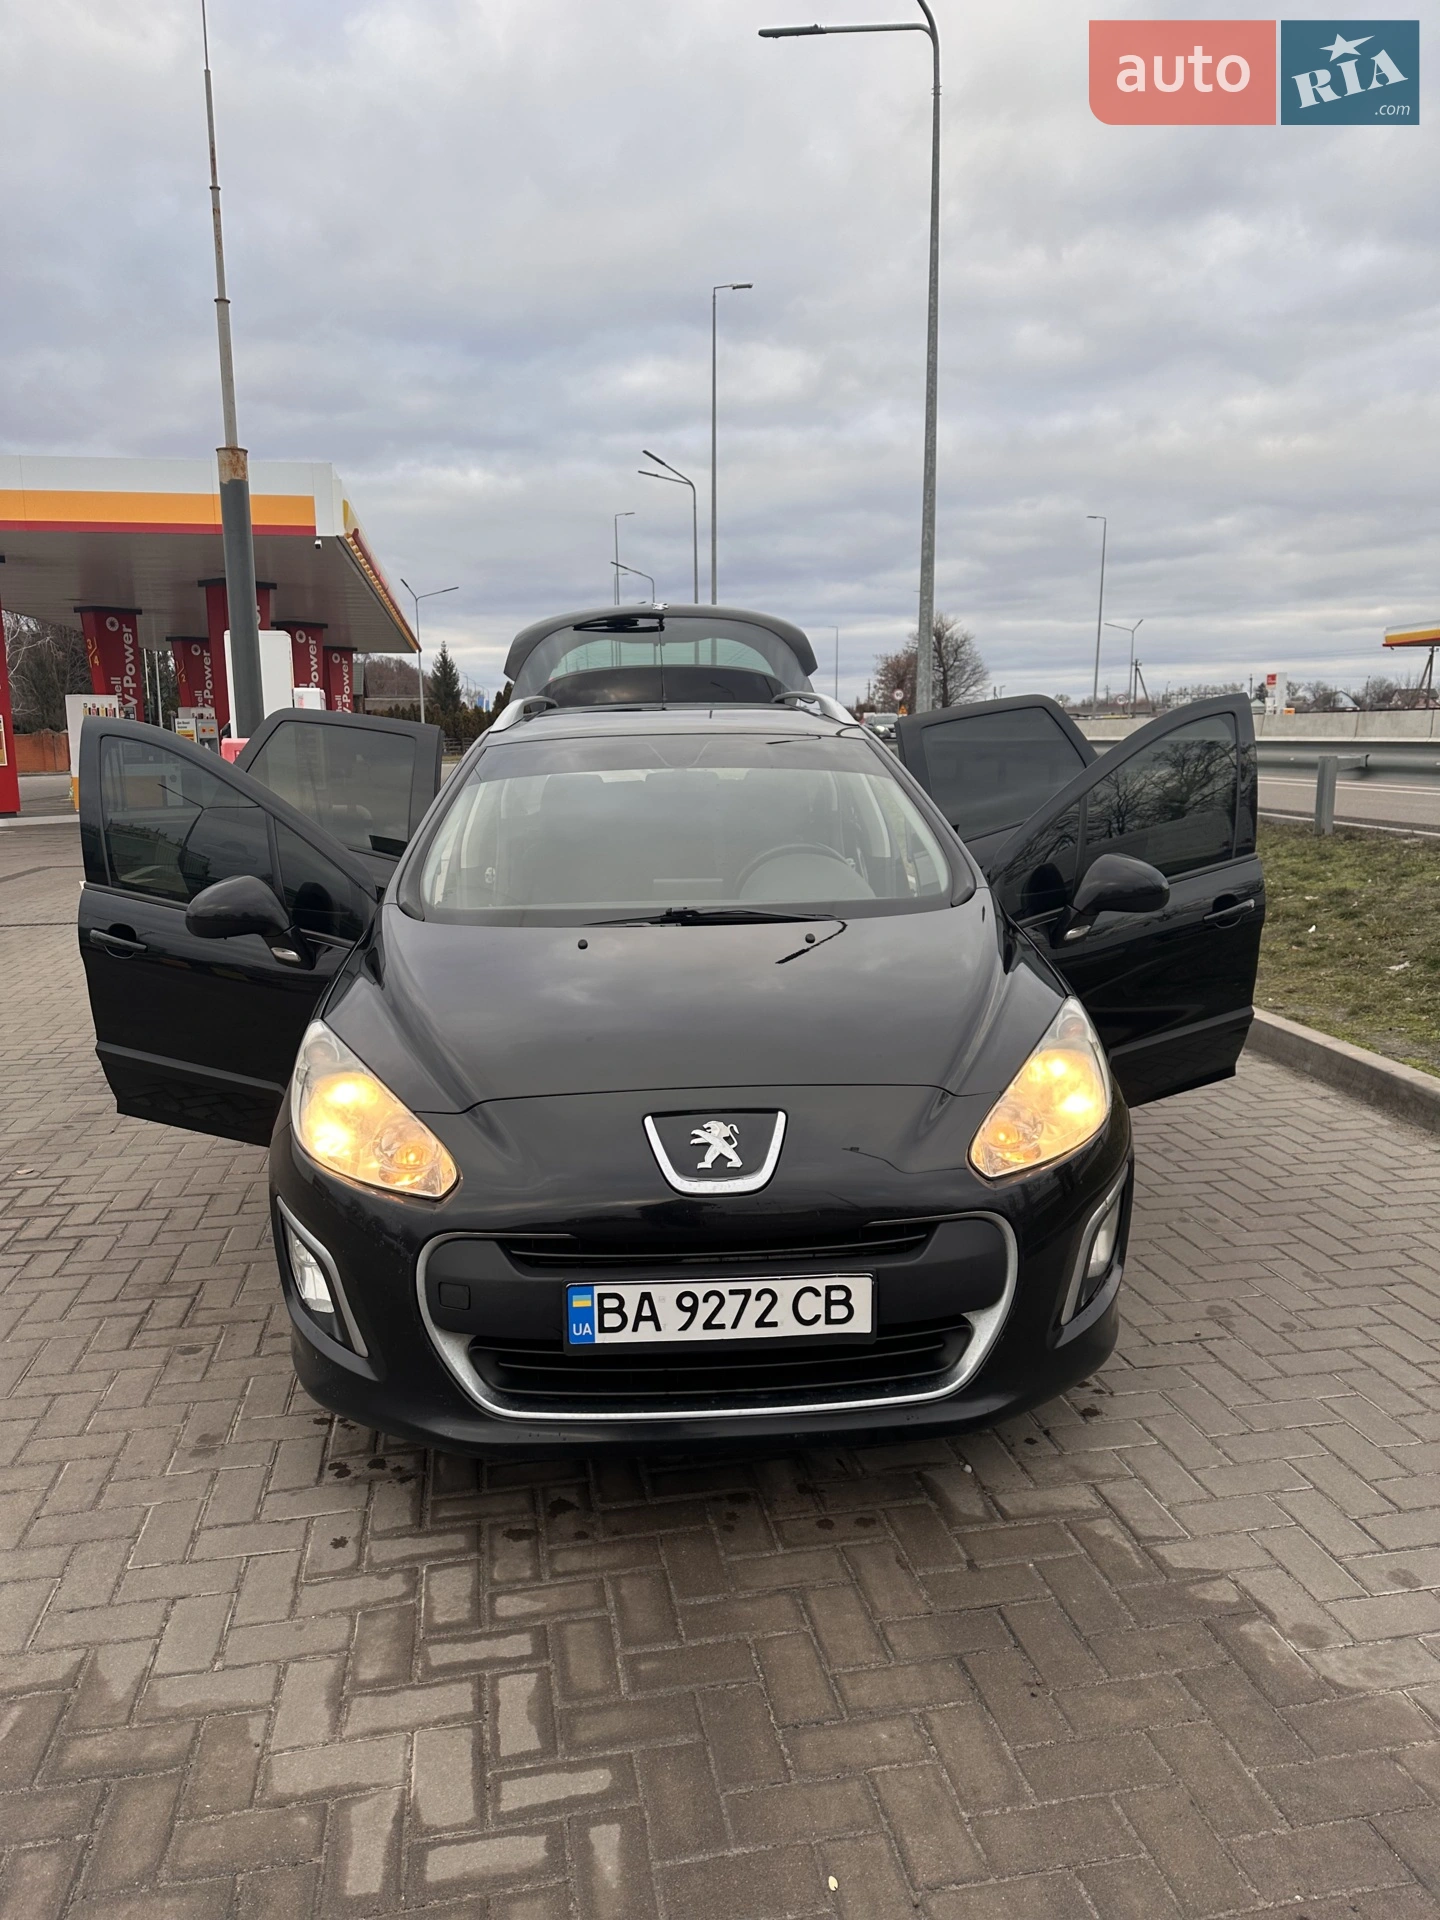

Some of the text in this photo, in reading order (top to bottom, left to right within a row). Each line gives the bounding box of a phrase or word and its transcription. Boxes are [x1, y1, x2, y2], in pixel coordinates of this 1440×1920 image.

[87, 638, 92, 650] 3
[94, 656, 100, 666] 4
[597, 1284, 855, 1334] BA 9272 CB
[573, 1323, 592, 1336] UA
